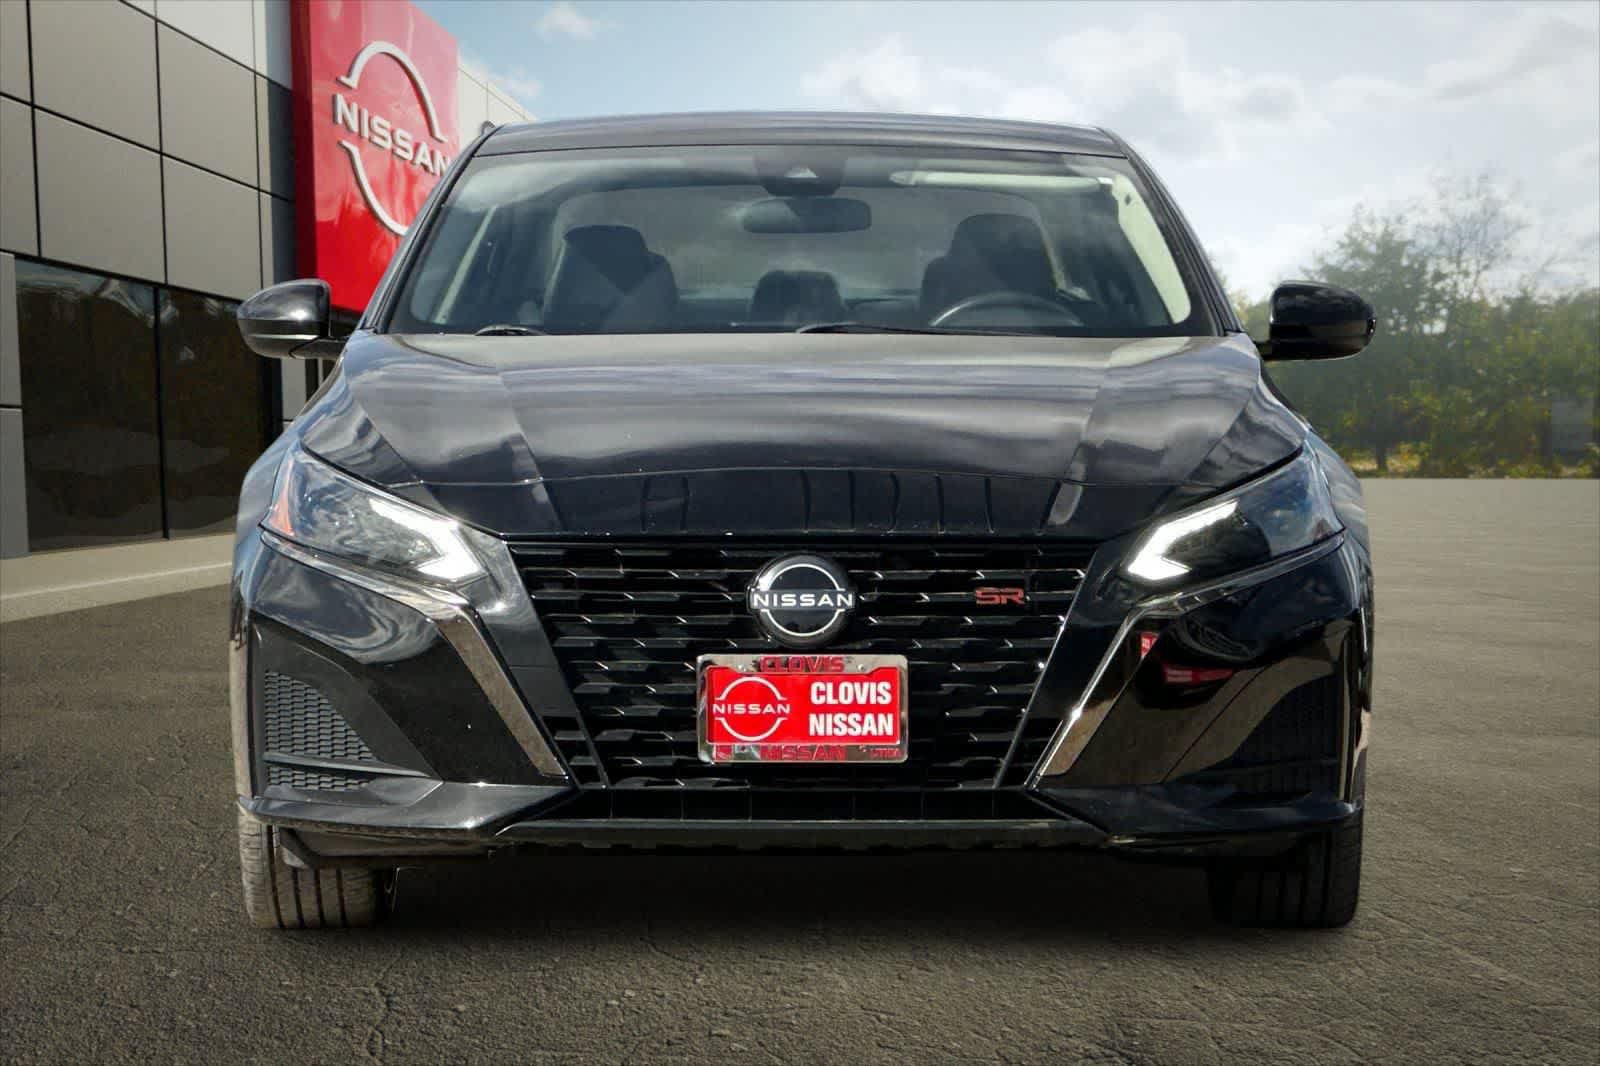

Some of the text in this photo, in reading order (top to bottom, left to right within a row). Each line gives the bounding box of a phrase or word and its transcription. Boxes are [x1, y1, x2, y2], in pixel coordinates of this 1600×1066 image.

[332, 93, 450, 176] NISSAN
[752, 594, 852, 607] NISSAN
[975, 587, 1025, 605] SR
[759, 656, 845, 672] CLOVIS
[810, 682, 892, 705] CLOVIS
[712, 703, 791, 714] NISSAN
[808, 713, 894, 736] NISSAN
